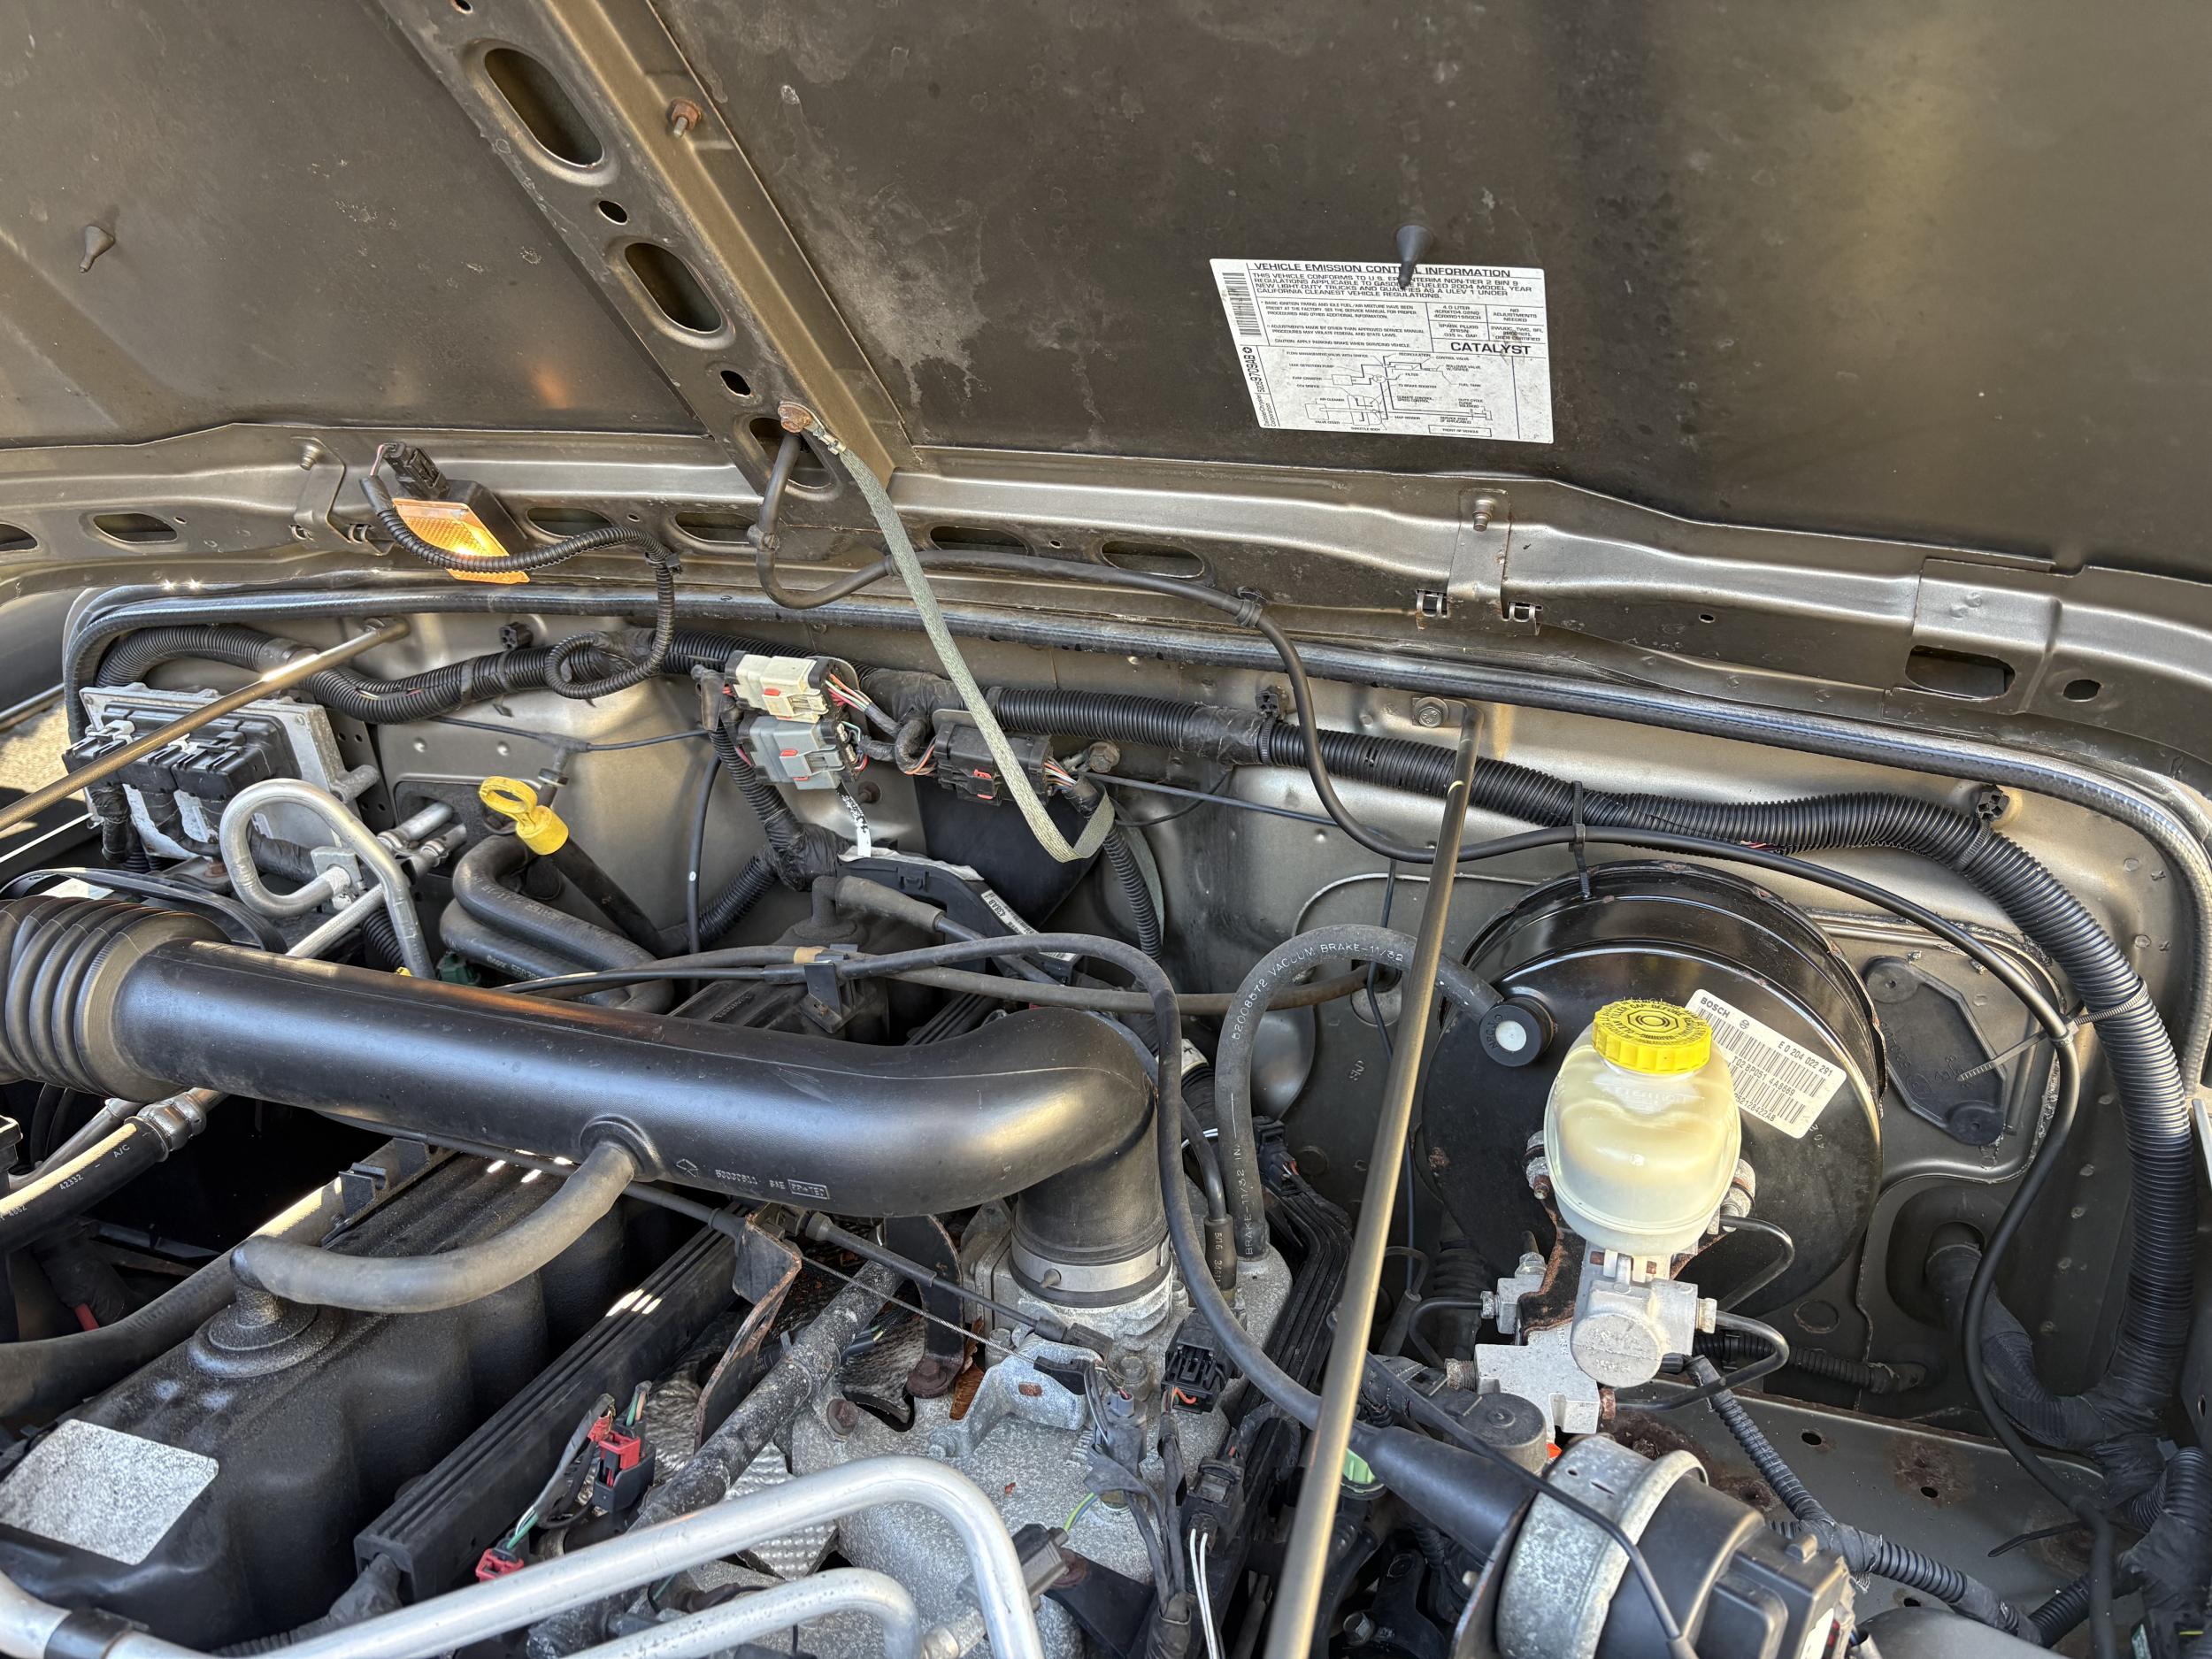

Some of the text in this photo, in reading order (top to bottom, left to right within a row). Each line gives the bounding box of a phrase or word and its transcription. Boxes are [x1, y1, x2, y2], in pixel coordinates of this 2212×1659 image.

[1425, 268, 1510, 277] INFORMATION
[1451, 342, 1531, 354] CATALYST
[1268, 947, 1313, 977] VACUUM
[1701, 996, 1731, 1018] BOSCH
[1790, 1048, 1805, 1060] 204
[1805, 1056, 1819, 1069] 022
[1819, 1064, 1833, 1077] 291
[113, 1144, 130, 1158] A/C
